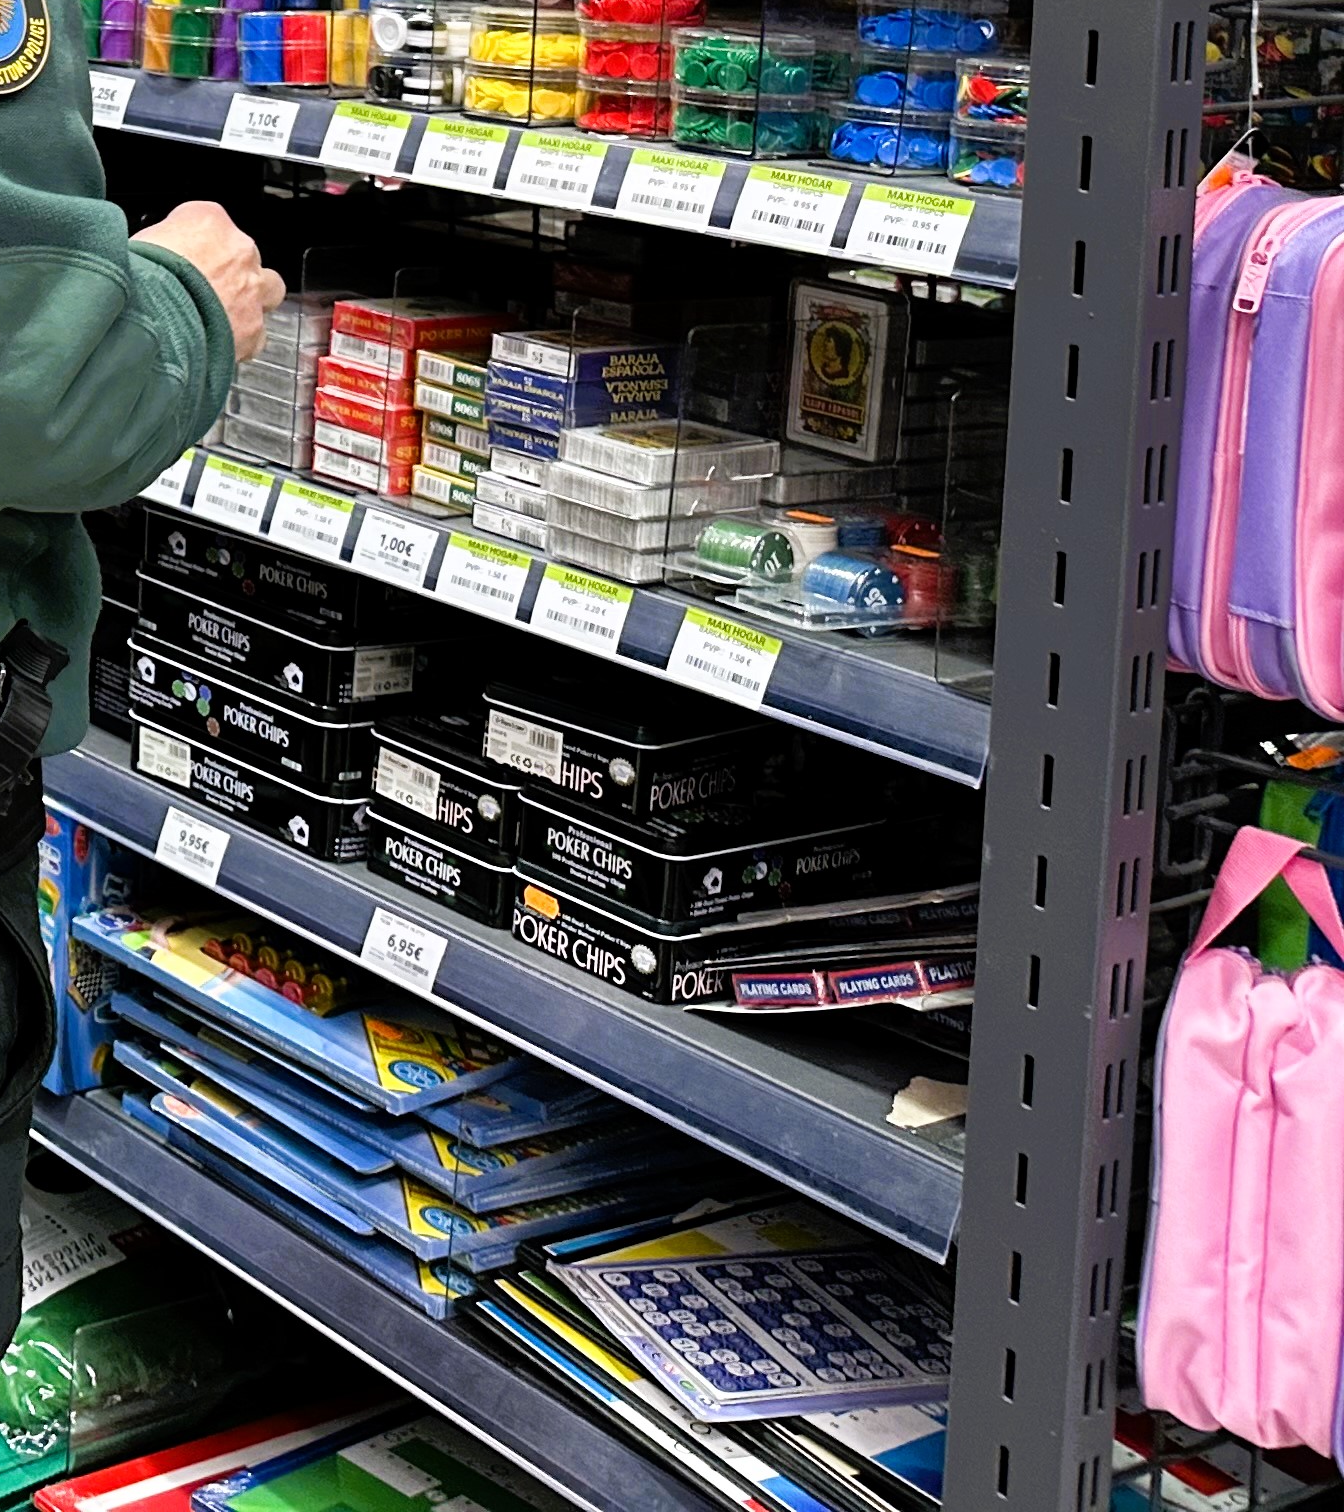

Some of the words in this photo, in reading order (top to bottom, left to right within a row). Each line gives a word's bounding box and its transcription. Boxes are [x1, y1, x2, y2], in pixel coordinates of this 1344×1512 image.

[24, 17, 45, 63] POLICE
[248, 111, 280, 128] 1,10€
[444, 123, 465, 135] MAXI
[465, 126, 494, 138] HOGAR
[538, 137, 561, 149] MAXI
[561, 140, 592, 154] HOGAR
[651, 153, 675, 167] MAXI
[676, 157, 709, 173] HOGAR
[771, 170, 796, 184] MAXI
[798, 175, 833, 191] HOGAR
[887, 189, 914, 204] MAXI
[916, 194, 955, 211] HOGAR
[912, 219, 931, 231] 0.95
[419, 327, 462, 342] POKER
[602, 363, 665, 378] ESPAÑOLA
[610, 353, 659, 366] BARAJA
[612, 391, 661, 404] BARAJA
[611, 409, 658, 422] BARAJA
[380, 533, 415, 557] 1,00€
[467, 539, 490, 554] MAXI
[490, 545, 519, 562] HOGAR
[259, 564, 294, 590] POKER
[295, 573, 328, 599] CHIPS
[564, 571, 588, 587] MAXI
[588, 577, 619, 598] HOGAR
[188, 612, 220, 641] POKER
[220, 624, 251, 652] CHIPS
[707, 616, 732, 632] MAXI
[732, 622, 767, 647] HOGAR
[223, 704, 257, 734] POKER
[257, 719, 290, 748] CHIPS
[190, 759, 222, 788] POKER
[223, 774, 254, 803] CHIPS
[562, 760, 604, 800] HIPS
[650, 777, 695, 812] POKER
[698, 766, 737, 800] CHIPS
[438, 795, 474, 834] HIPS
[179, 828, 210, 855] 9,95€
[568, 824, 613, 851] Professional
[385, 836, 424, 871] POKER
[425, 854, 462, 887] CHIPS
[546, 827, 590, 862] POKER
[592, 847, 633, 880] CHIPS
[795, 851, 829, 876] POKER
[831, 847, 861, 869] CHIPS
[387, 934, 424, 961] 6,95€
[512, 908, 569, 960] POKER
[572, 939, 627, 986] CHIPS
[671, 969, 725, 1002] POKER
[739, 982, 777, 996] PLAYING
[779, 982, 812, 996] CARDS
[839, 975, 879, 995] PLAYING
[880, 972, 914, 989] CARDS
[43, 1231, 99, 1264] JUEGOS
[53, 1241, 108, 1279] MANTEL
[20, 1269, 54, 1300] PAR
